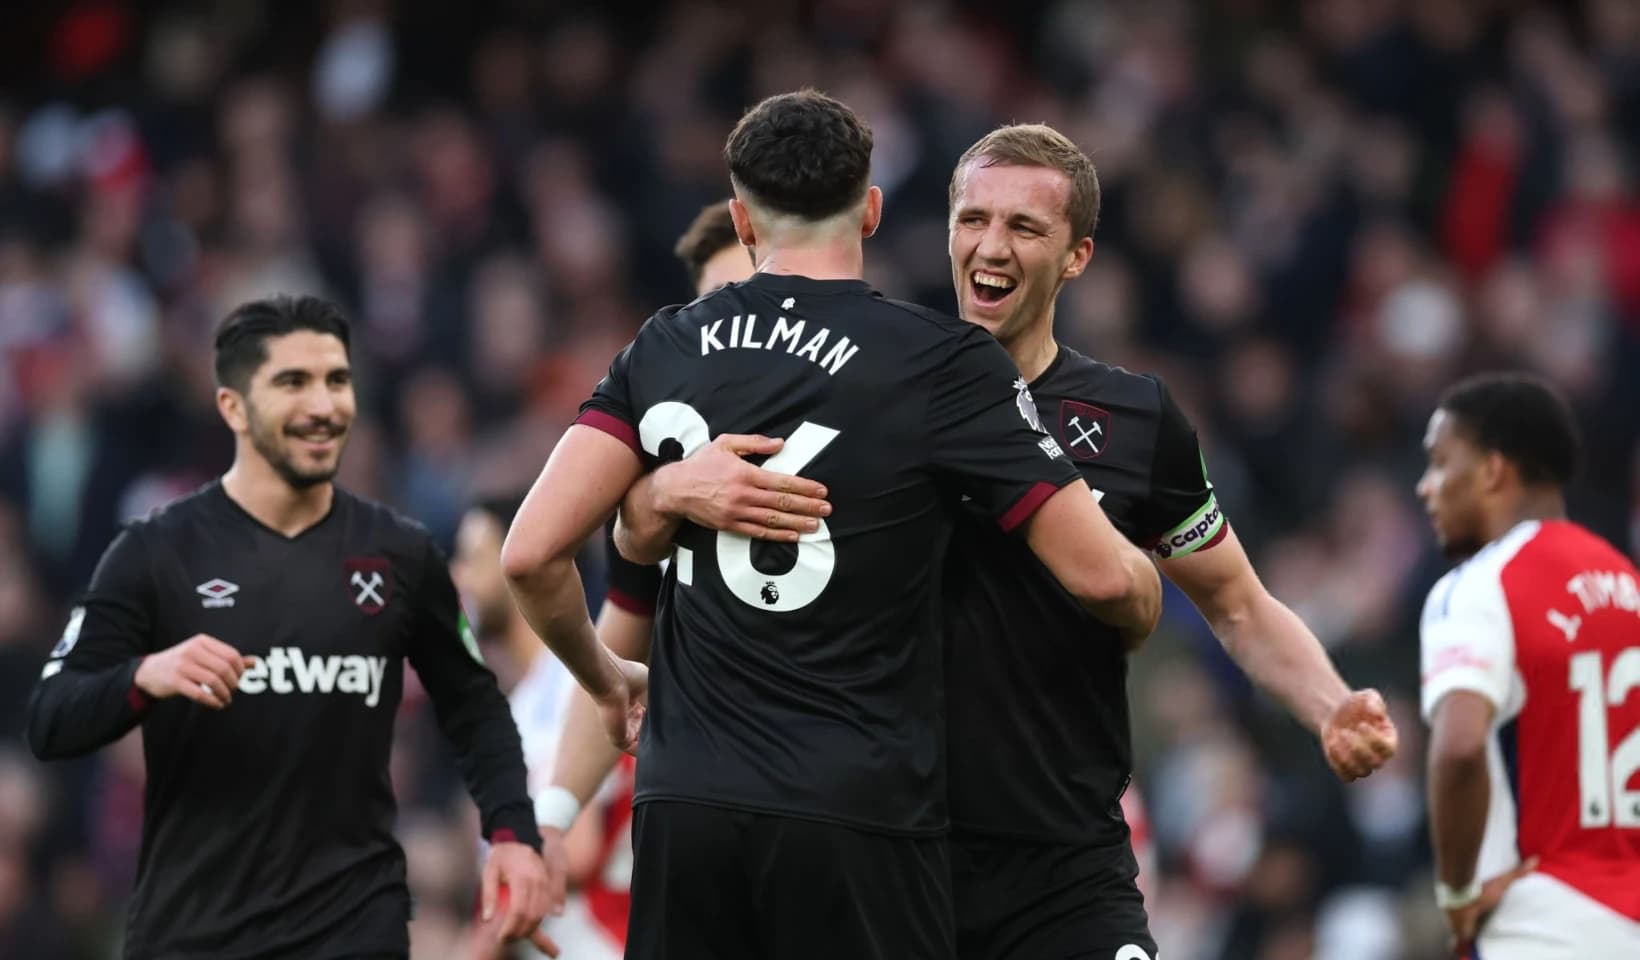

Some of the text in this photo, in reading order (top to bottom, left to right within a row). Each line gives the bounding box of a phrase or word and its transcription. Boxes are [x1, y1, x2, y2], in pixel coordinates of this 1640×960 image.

[700, 314, 860, 376] KILMAN
[1567, 570, 1640, 615] TIMB
[238, 646, 388, 707] etway
